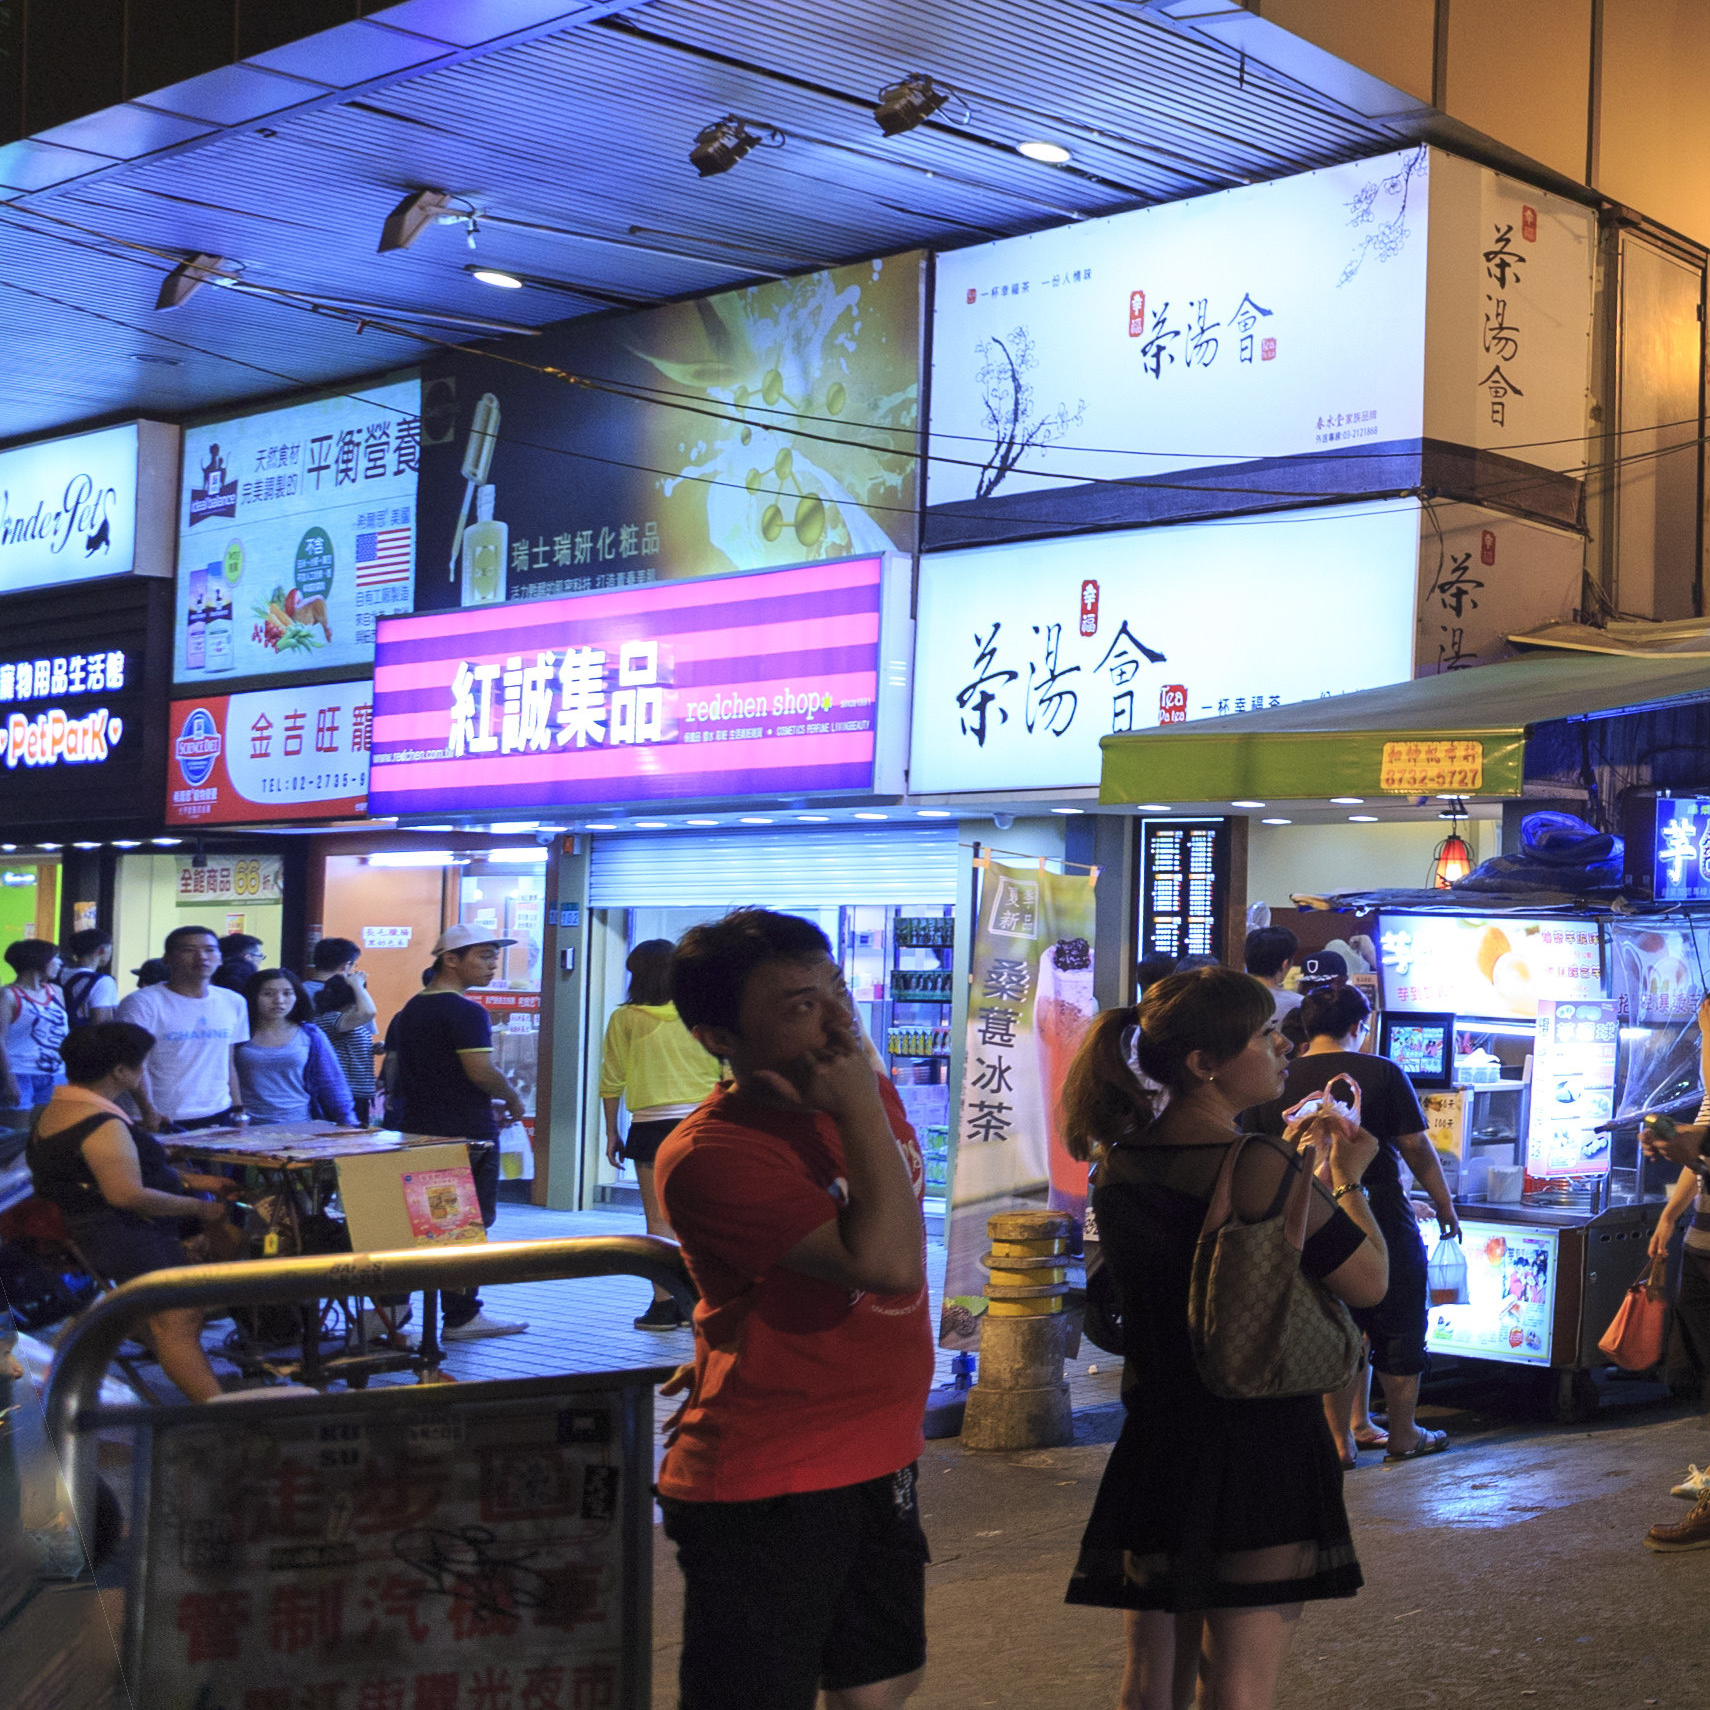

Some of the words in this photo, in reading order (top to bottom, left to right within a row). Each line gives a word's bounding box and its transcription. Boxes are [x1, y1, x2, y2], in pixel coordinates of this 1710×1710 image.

[980, 281, 1030, 299] 一杯幸福茶
[1140, 292, 1274, 379] 茶湯會
[1479, 225, 1527, 427] 茶湯會
[307, 417, 421, 490] 平衡營養
[1081, 583, 1096, 633] 幸福
[449, 641, 663, 757] 紅誠集品
[685, 691, 768, 723] redchen
[772, 688, 821, 720] shop
[956, 620, 1166, 747] 茶湯會
[1201, 695, 1281, 714] 一杯幸福茶
[7, 709, 109, 768] PetPark
